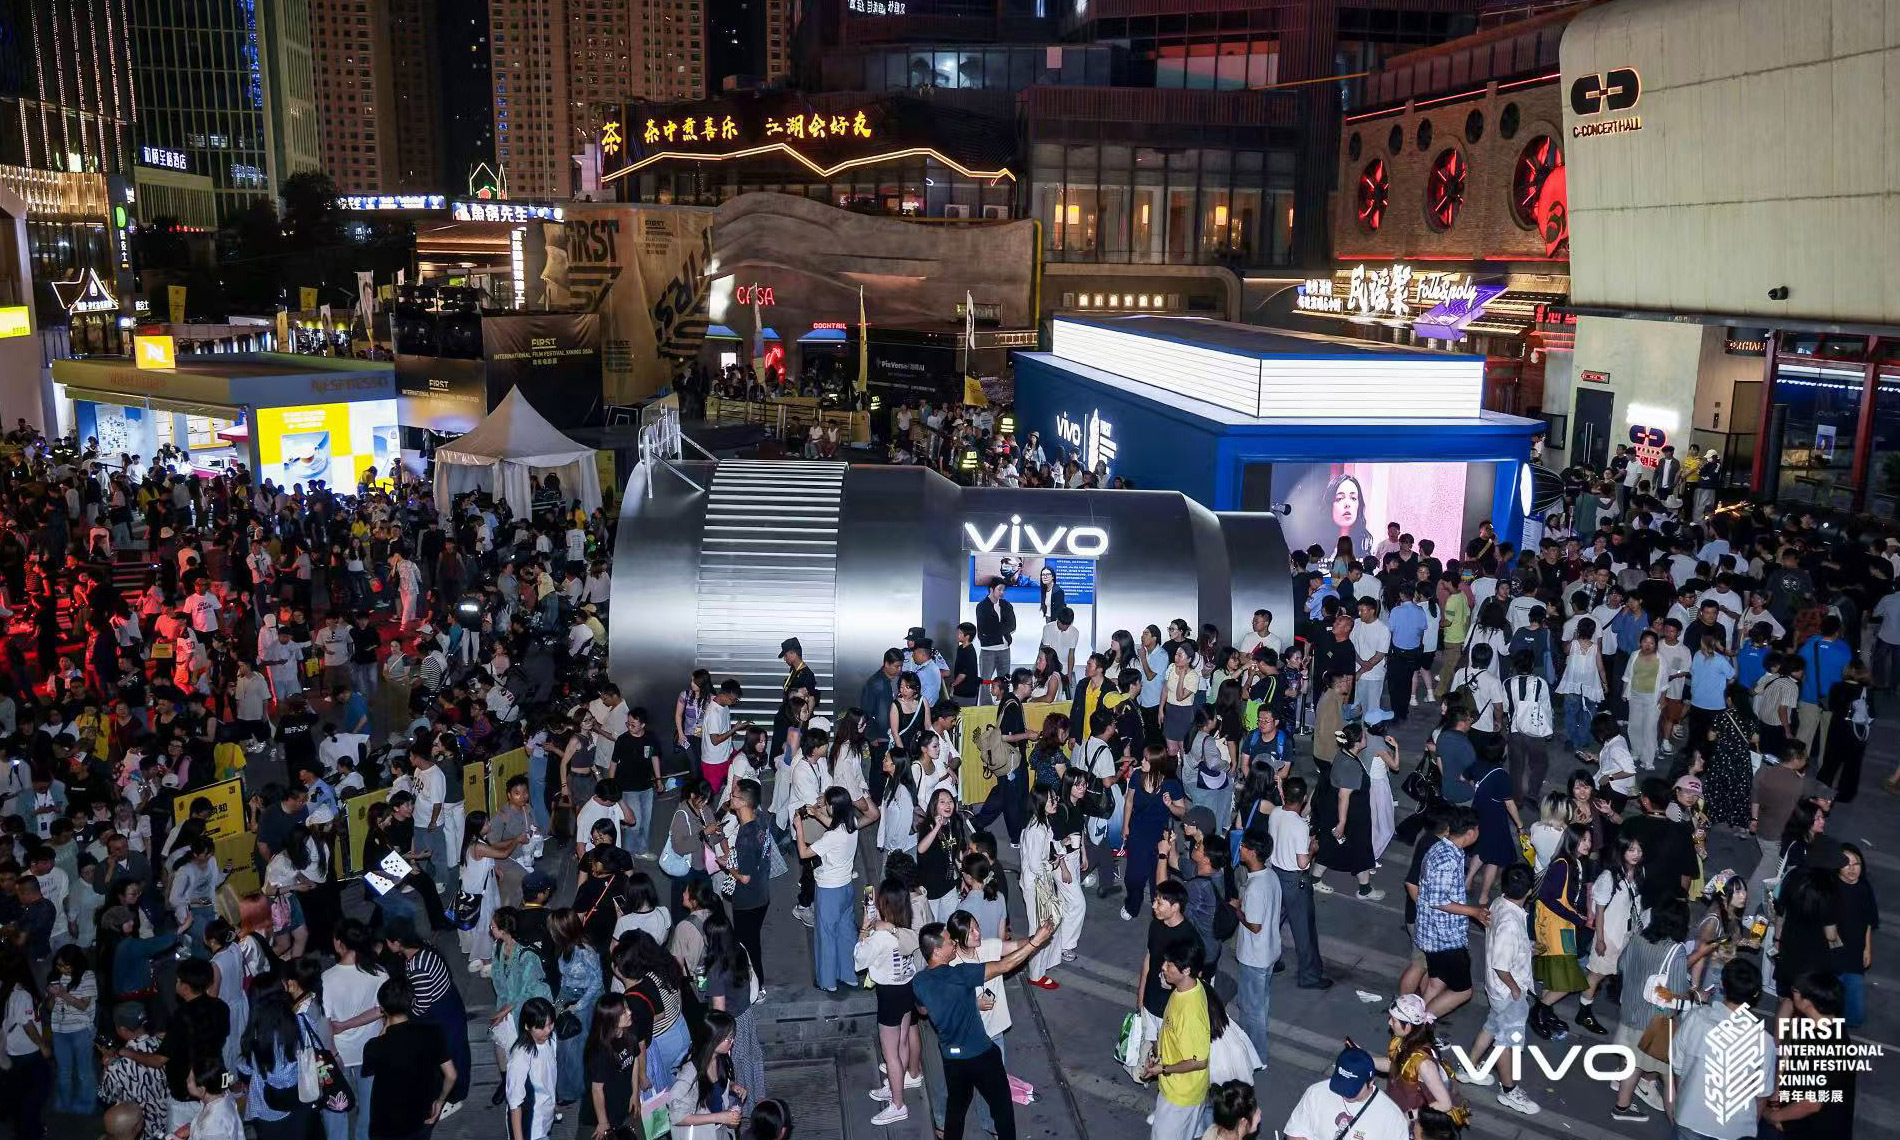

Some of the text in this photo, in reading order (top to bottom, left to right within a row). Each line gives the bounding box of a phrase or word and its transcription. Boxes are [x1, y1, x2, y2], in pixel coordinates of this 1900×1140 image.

[532, 338, 556, 347] FIRST
[429, 379, 449, 388] FIRST
[1056, 411, 1081, 447] vivo
[965, 514, 1109, 556] vivo
